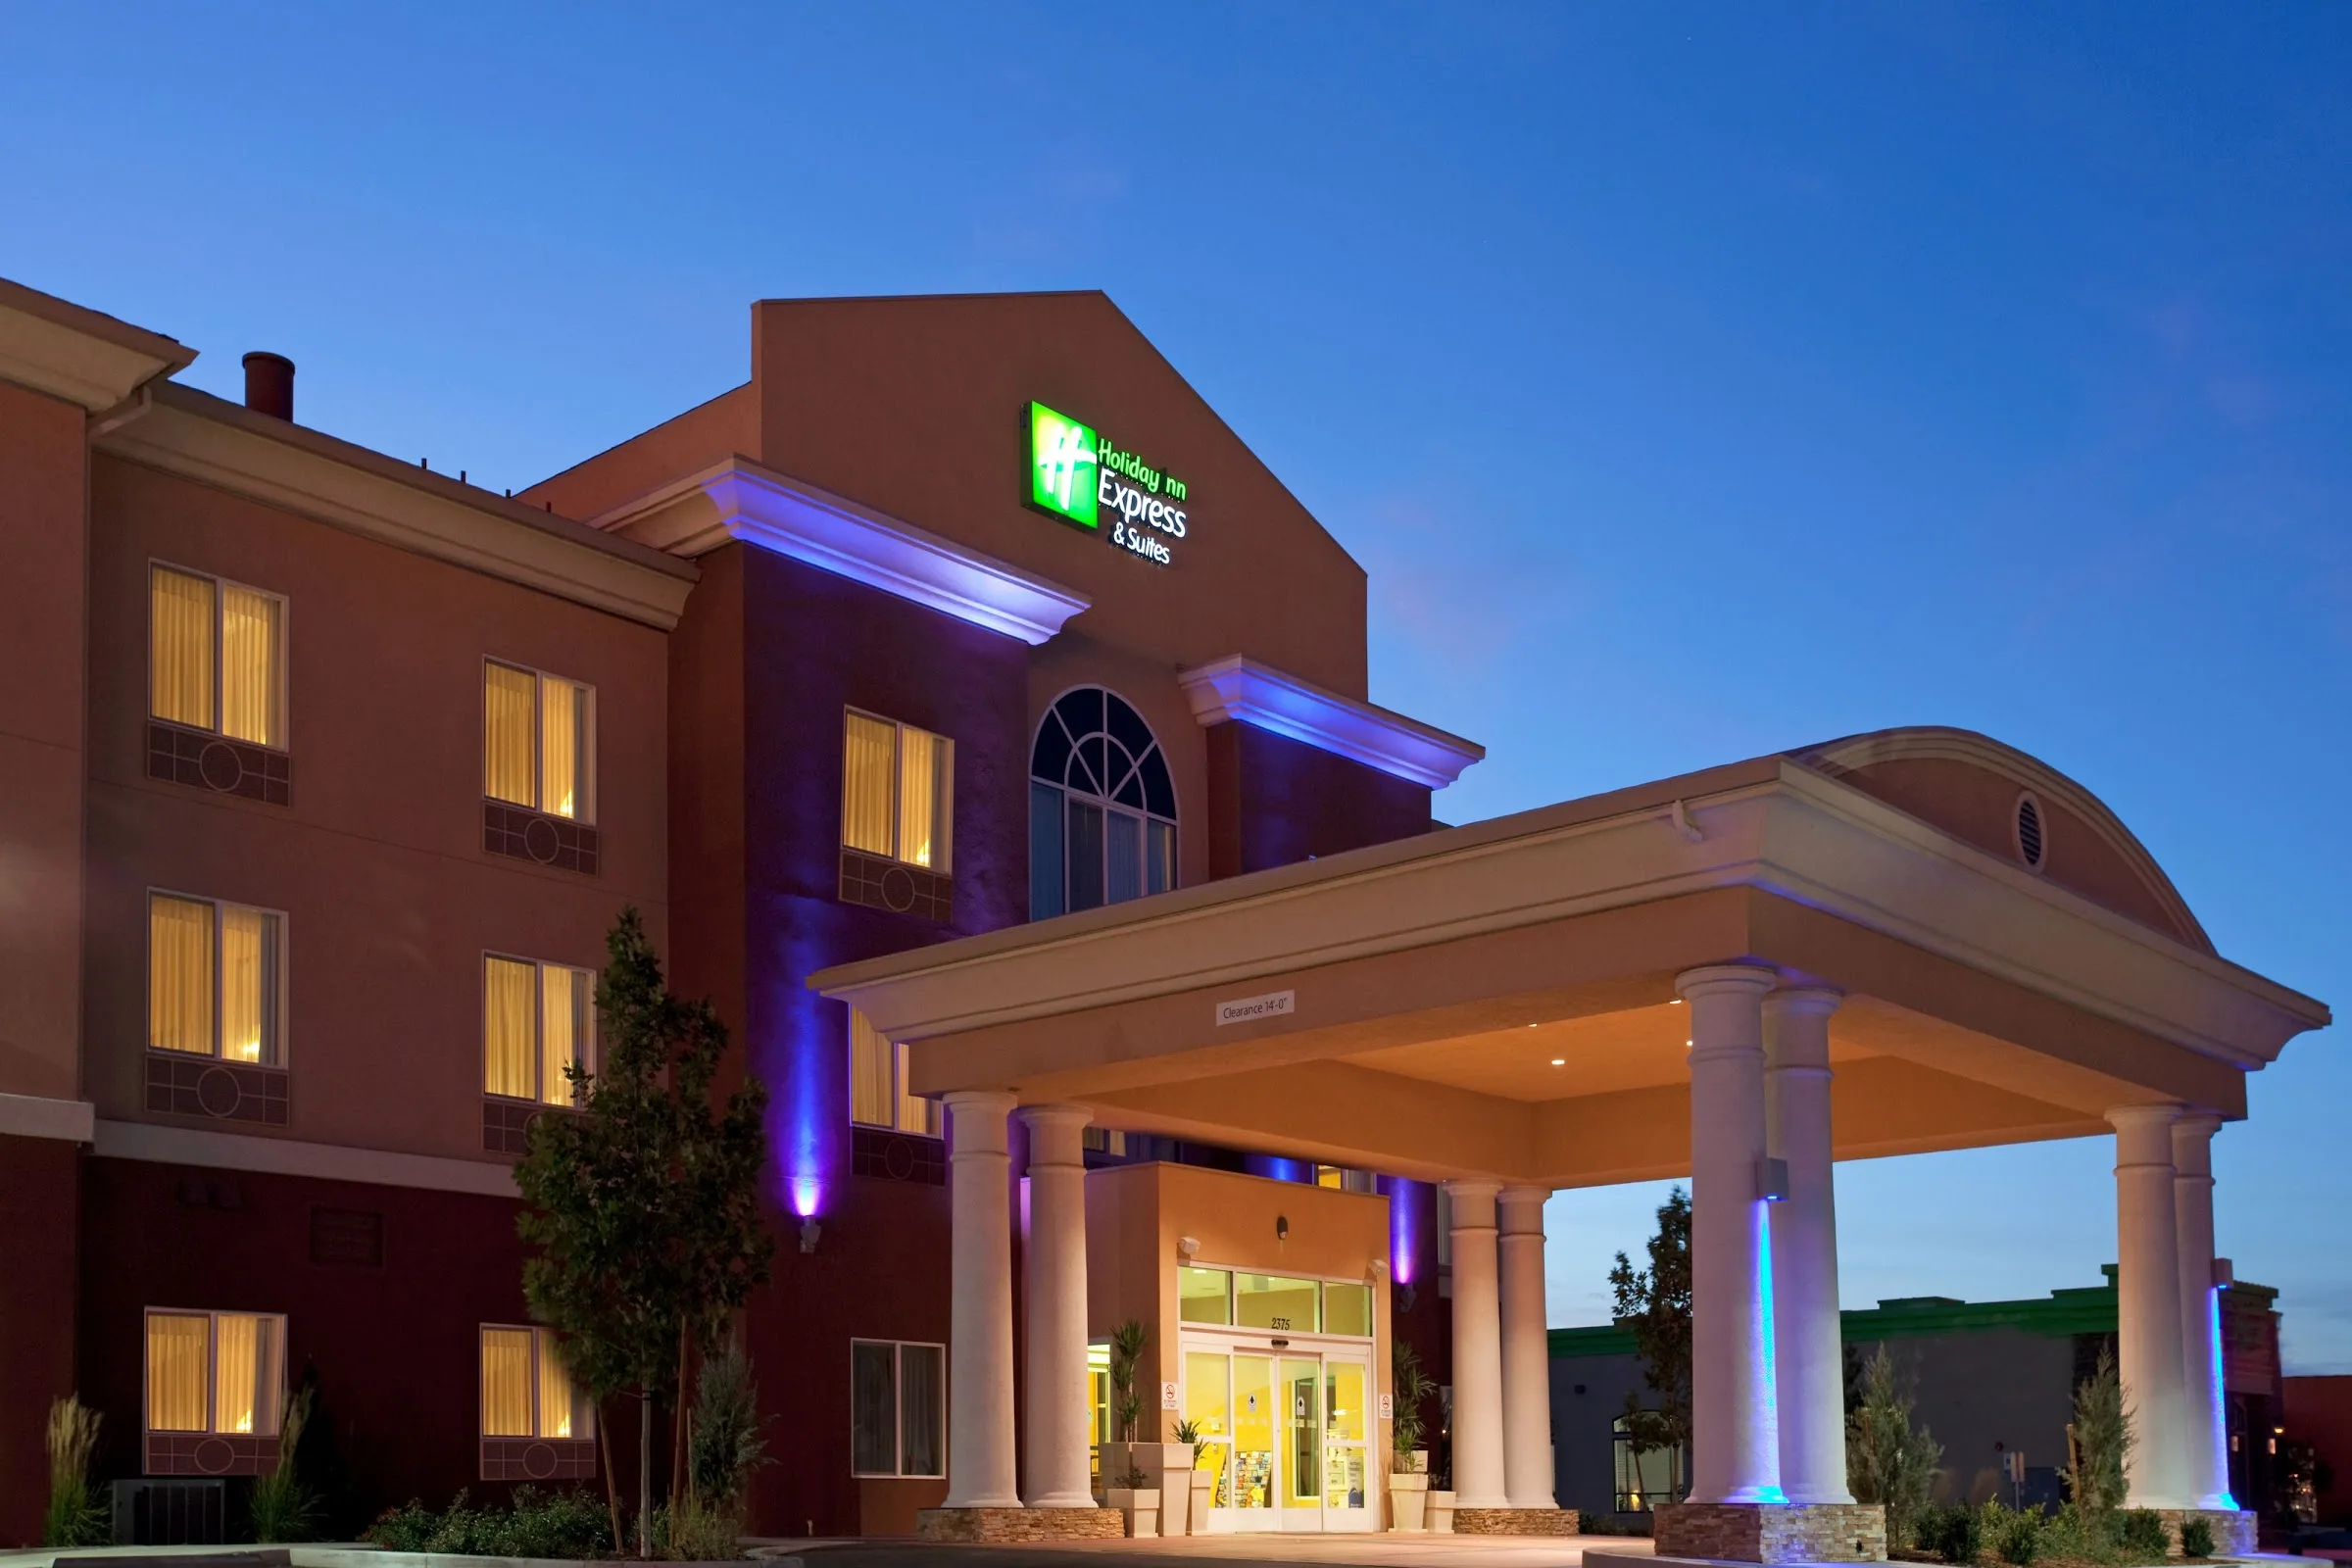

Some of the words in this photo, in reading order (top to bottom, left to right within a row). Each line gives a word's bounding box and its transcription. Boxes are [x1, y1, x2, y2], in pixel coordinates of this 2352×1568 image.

[1099, 438, 1159, 493] Holiday
[1098, 467, 1187, 538] Express
[1113, 521, 1124, 545] &
[1127, 527, 1170, 564] Suites
[1223, 1004, 1262, 1018] Clearance
[1271, 1317, 1291, 1331] 2375
